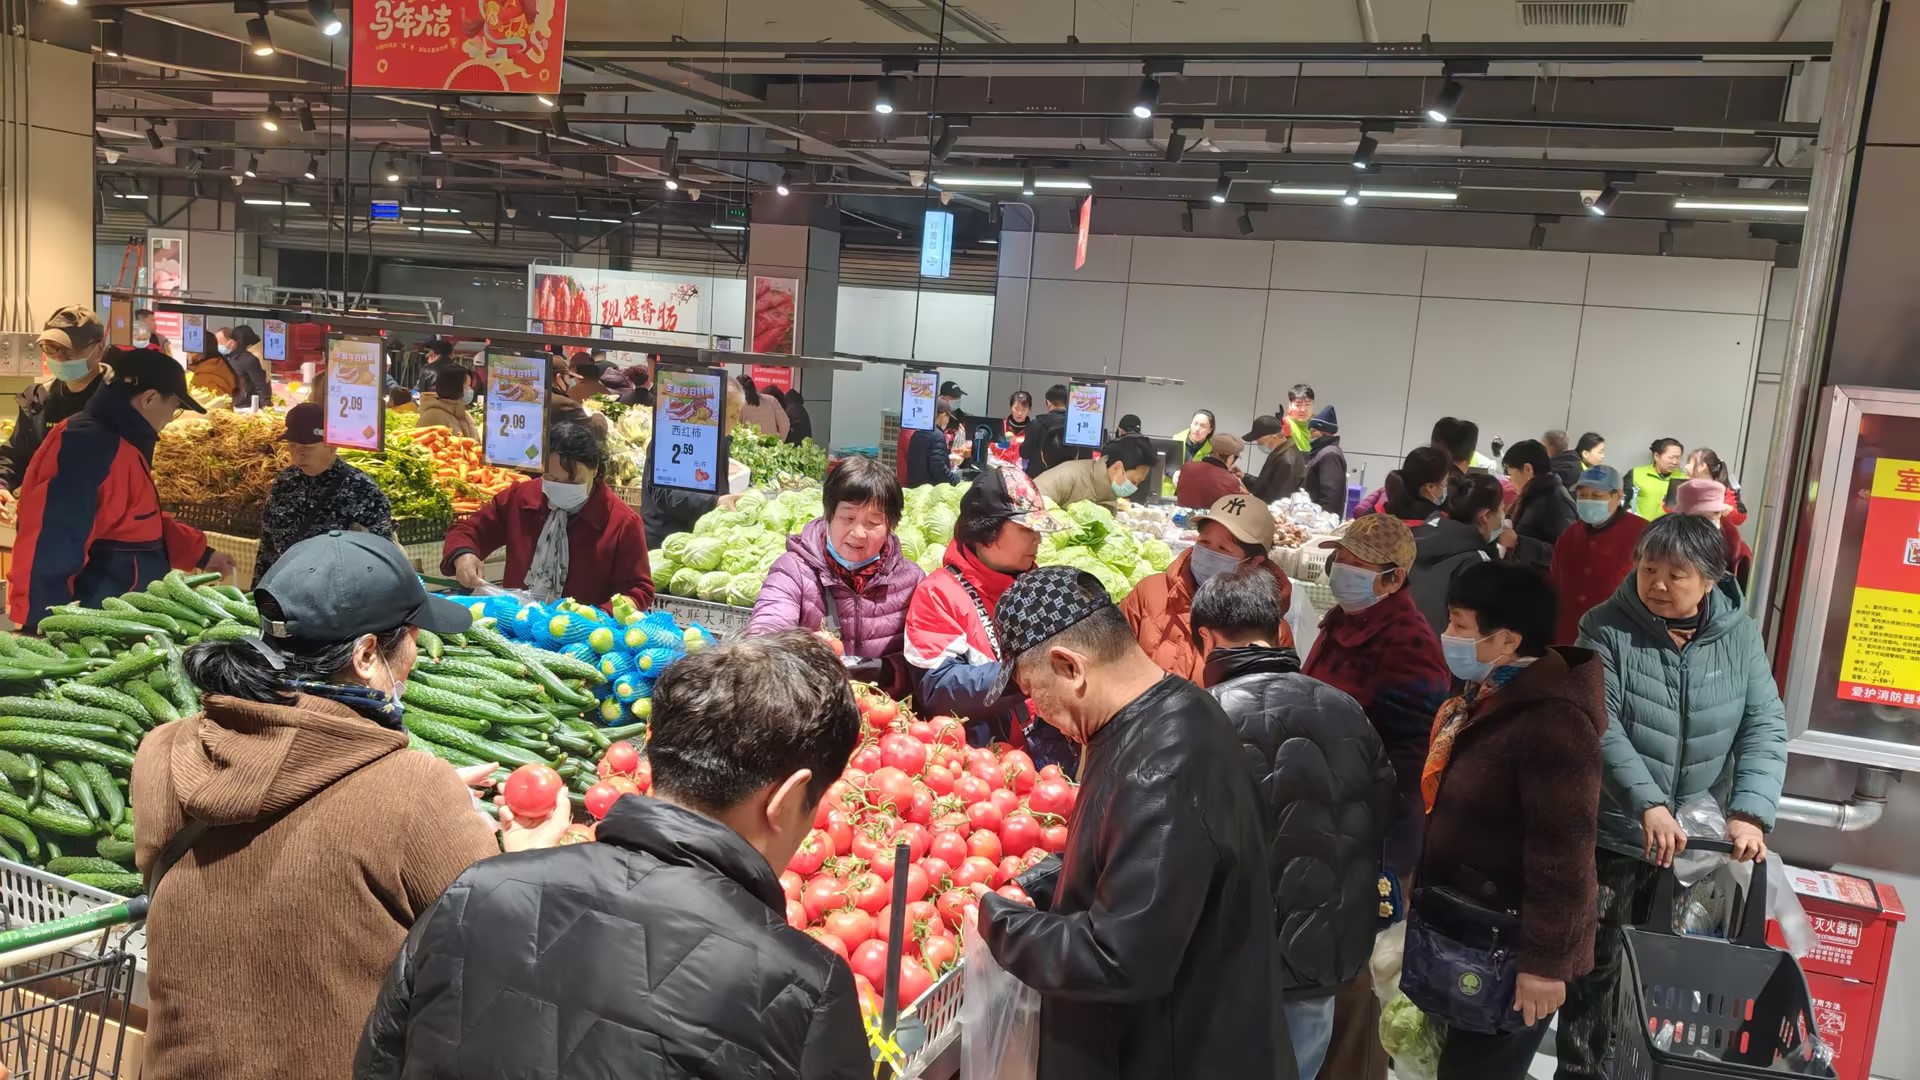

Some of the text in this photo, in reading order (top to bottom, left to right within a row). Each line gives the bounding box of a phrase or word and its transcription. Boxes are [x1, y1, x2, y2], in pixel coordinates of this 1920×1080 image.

[369, 0, 452, 40] 马年大吉
[602, 295, 678, 331] 现灌香肠
[339, 396, 363, 418] 2.09
[500, 414, 526, 437] 2.09
[672, 425, 702, 438] 西红柿
[671, 443, 694, 464] 2.59
